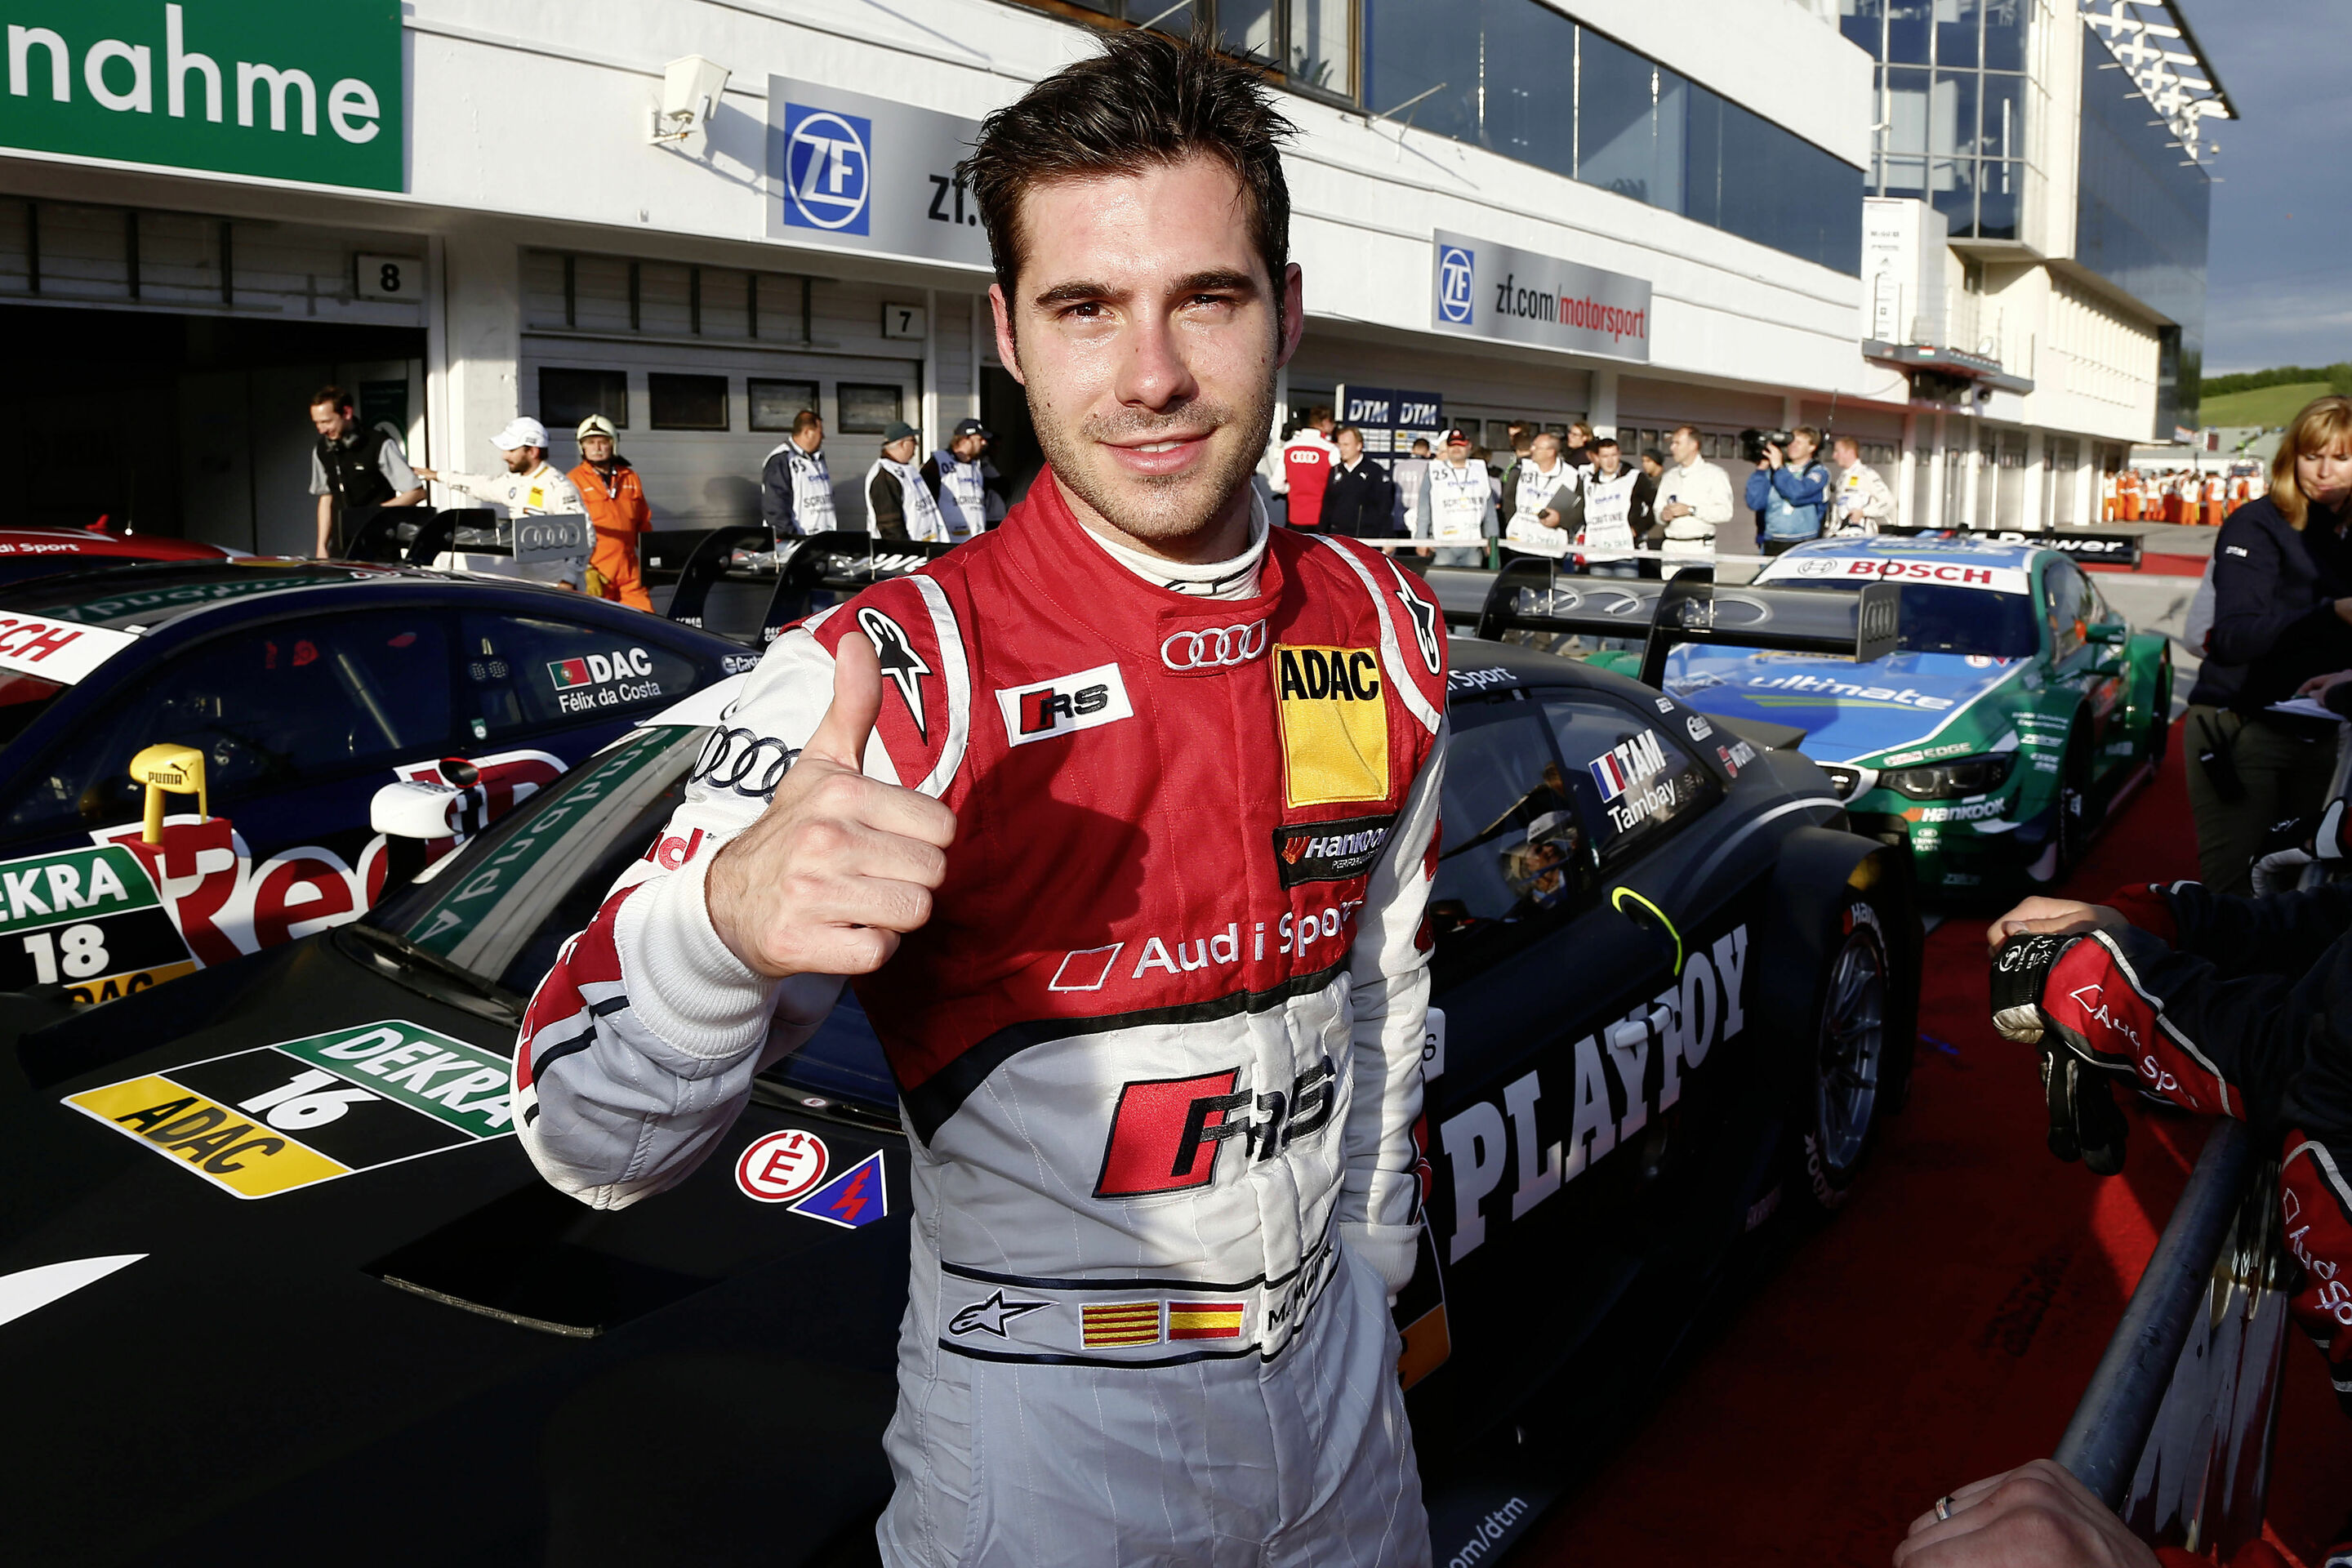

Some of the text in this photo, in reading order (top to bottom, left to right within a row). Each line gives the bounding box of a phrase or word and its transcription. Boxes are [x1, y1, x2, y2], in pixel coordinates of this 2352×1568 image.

[7, 4, 381, 145] nahme
[789, 122, 867, 219] ZF
[928, 161, 986, 228] zf.
[380, 263, 400, 292] 8
[1441, 259, 1473, 311] ZF
[899, 310, 912, 332] 7
[1495, 274, 1646, 343] zf.com/motorsport
[1348, 399, 1389, 424] DTM
[1399, 402, 1437, 425] DTM
[19, 543, 80, 554] Sport
[1847, 560, 1993, 585] BOSCH
[586, 647, 653, 684] DAC
[1280, 648, 1379, 702] ADAC
[1448, 666, 1517, 690] Sport
[558, 679, 662, 714] Félix da Costa
[1040, 684, 1109, 725] RS
[1614, 728, 1667, 786] TAM
[1923, 742, 1973, 759] EDGE
[148, 771, 183, 786] PUMA
[1606, 778, 1677, 834] Tambay
[0, 857, 129, 923] KRA
[90, 813, 389, 969] Re
[23, 924, 109, 984] 18
[1132, 920, 1265, 978] Audi
[237, 1068, 382, 1130] 16
[318, 1027, 513, 1129] DEKRA
[114, 1096, 286, 1174] ADAC
